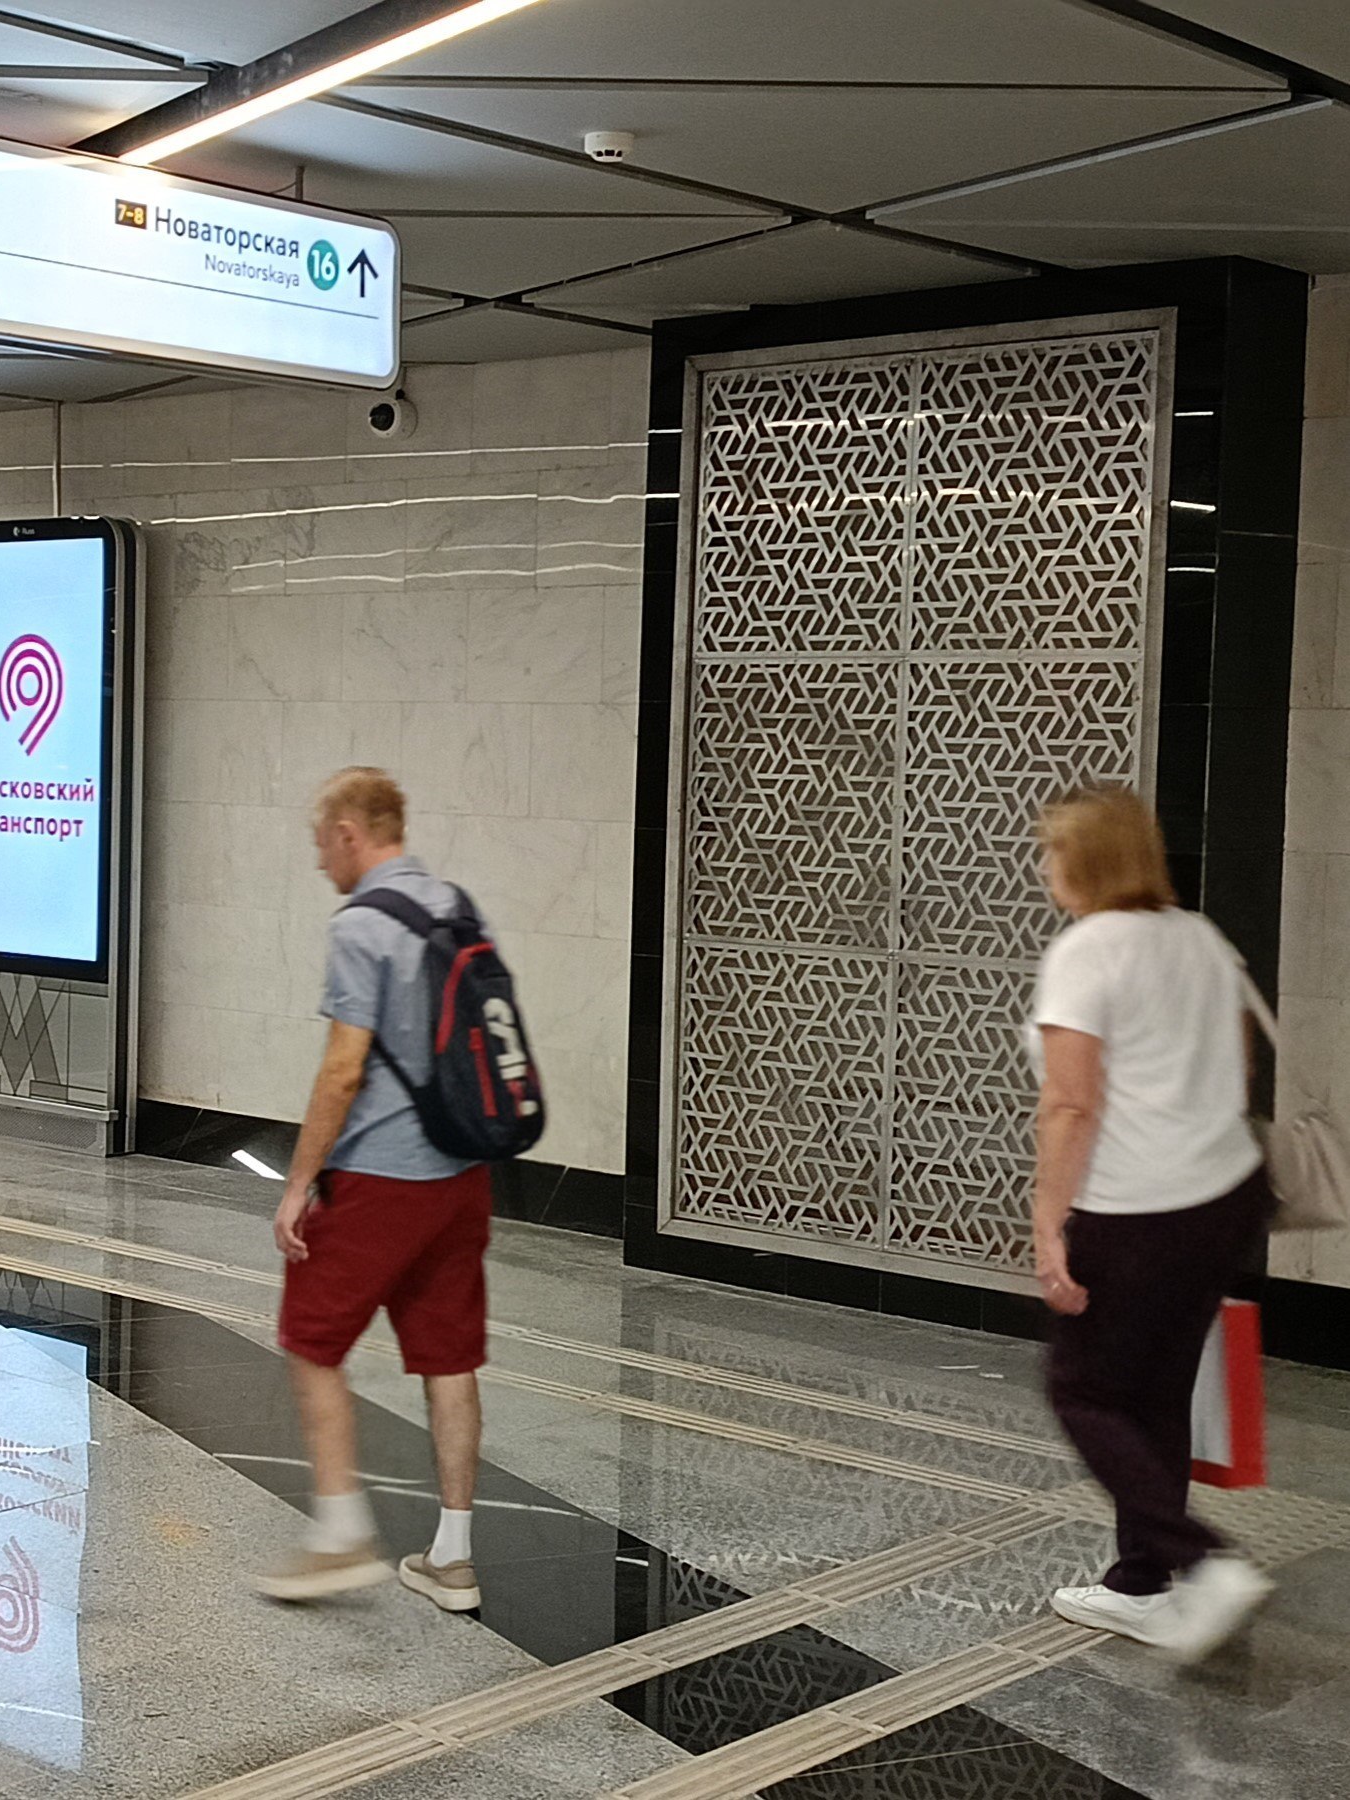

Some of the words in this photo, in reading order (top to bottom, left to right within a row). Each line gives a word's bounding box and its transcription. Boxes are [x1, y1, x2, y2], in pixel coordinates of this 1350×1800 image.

[117, 203, 145, 226] 7-8
[154, 206, 300, 259] Новаторская
[205, 254, 300, 289] Novatorskaya
[312, 249, 337, 282] 16
